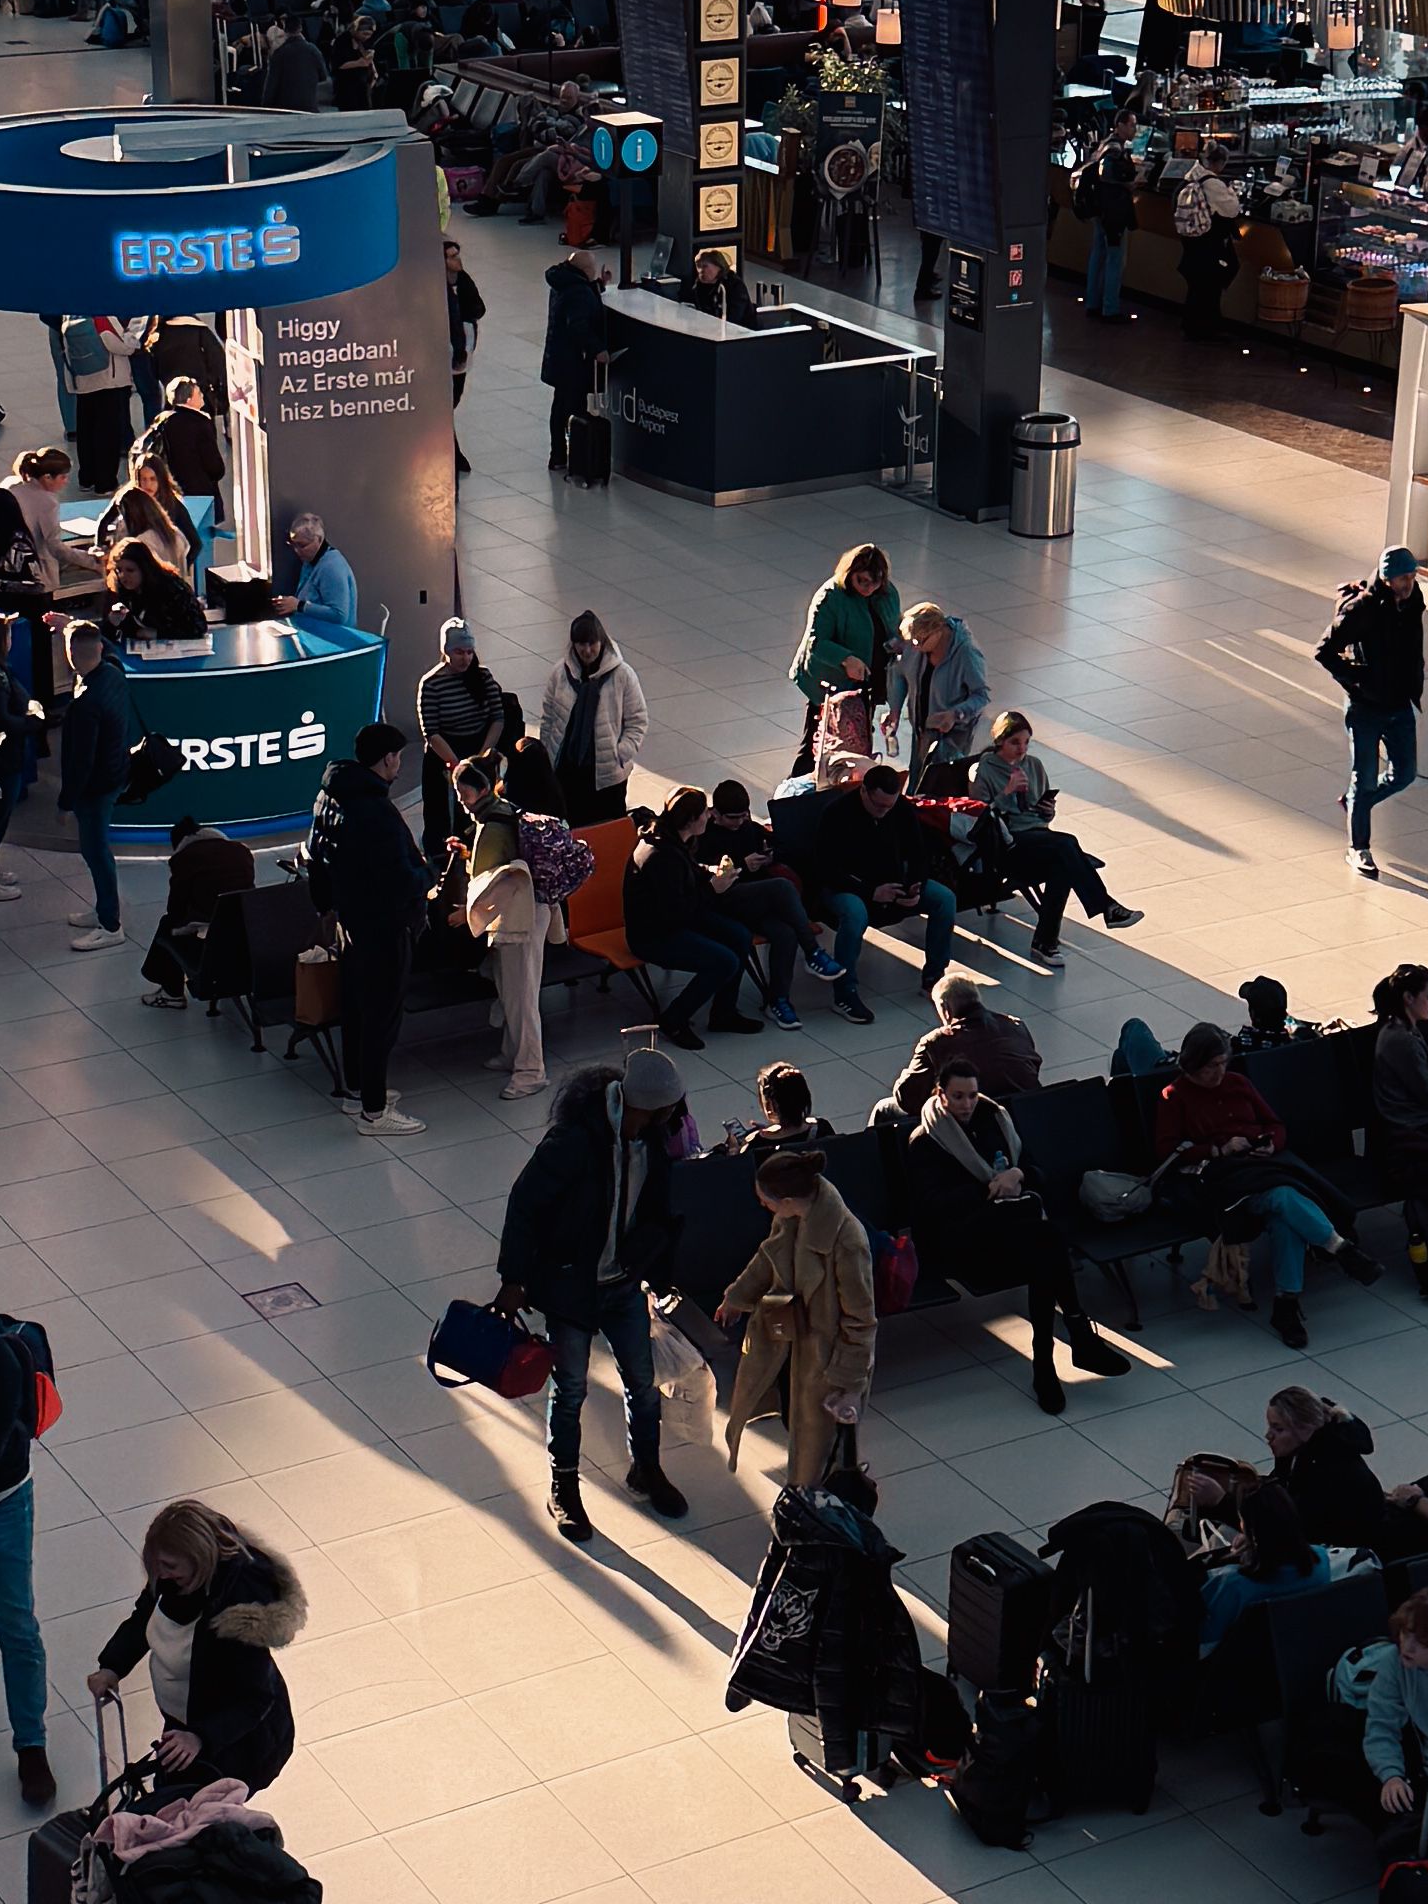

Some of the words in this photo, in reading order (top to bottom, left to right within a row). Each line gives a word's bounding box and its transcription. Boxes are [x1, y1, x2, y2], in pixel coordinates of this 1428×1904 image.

[121, 233, 255, 277] ERSTE
[277, 316, 341, 344] Higgy
[278, 341, 398, 371] magadban!
[279, 372, 310, 395] Az
[314, 371, 369, 393] Erste
[374, 366, 415, 387] már
[281, 400, 325, 423] hisz
[329, 395, 416, 418] benned.
[638, 398, 679, 424] Budapest
[638, 414, 665, 435] Airport
[903, 425, 929, 454] bud
